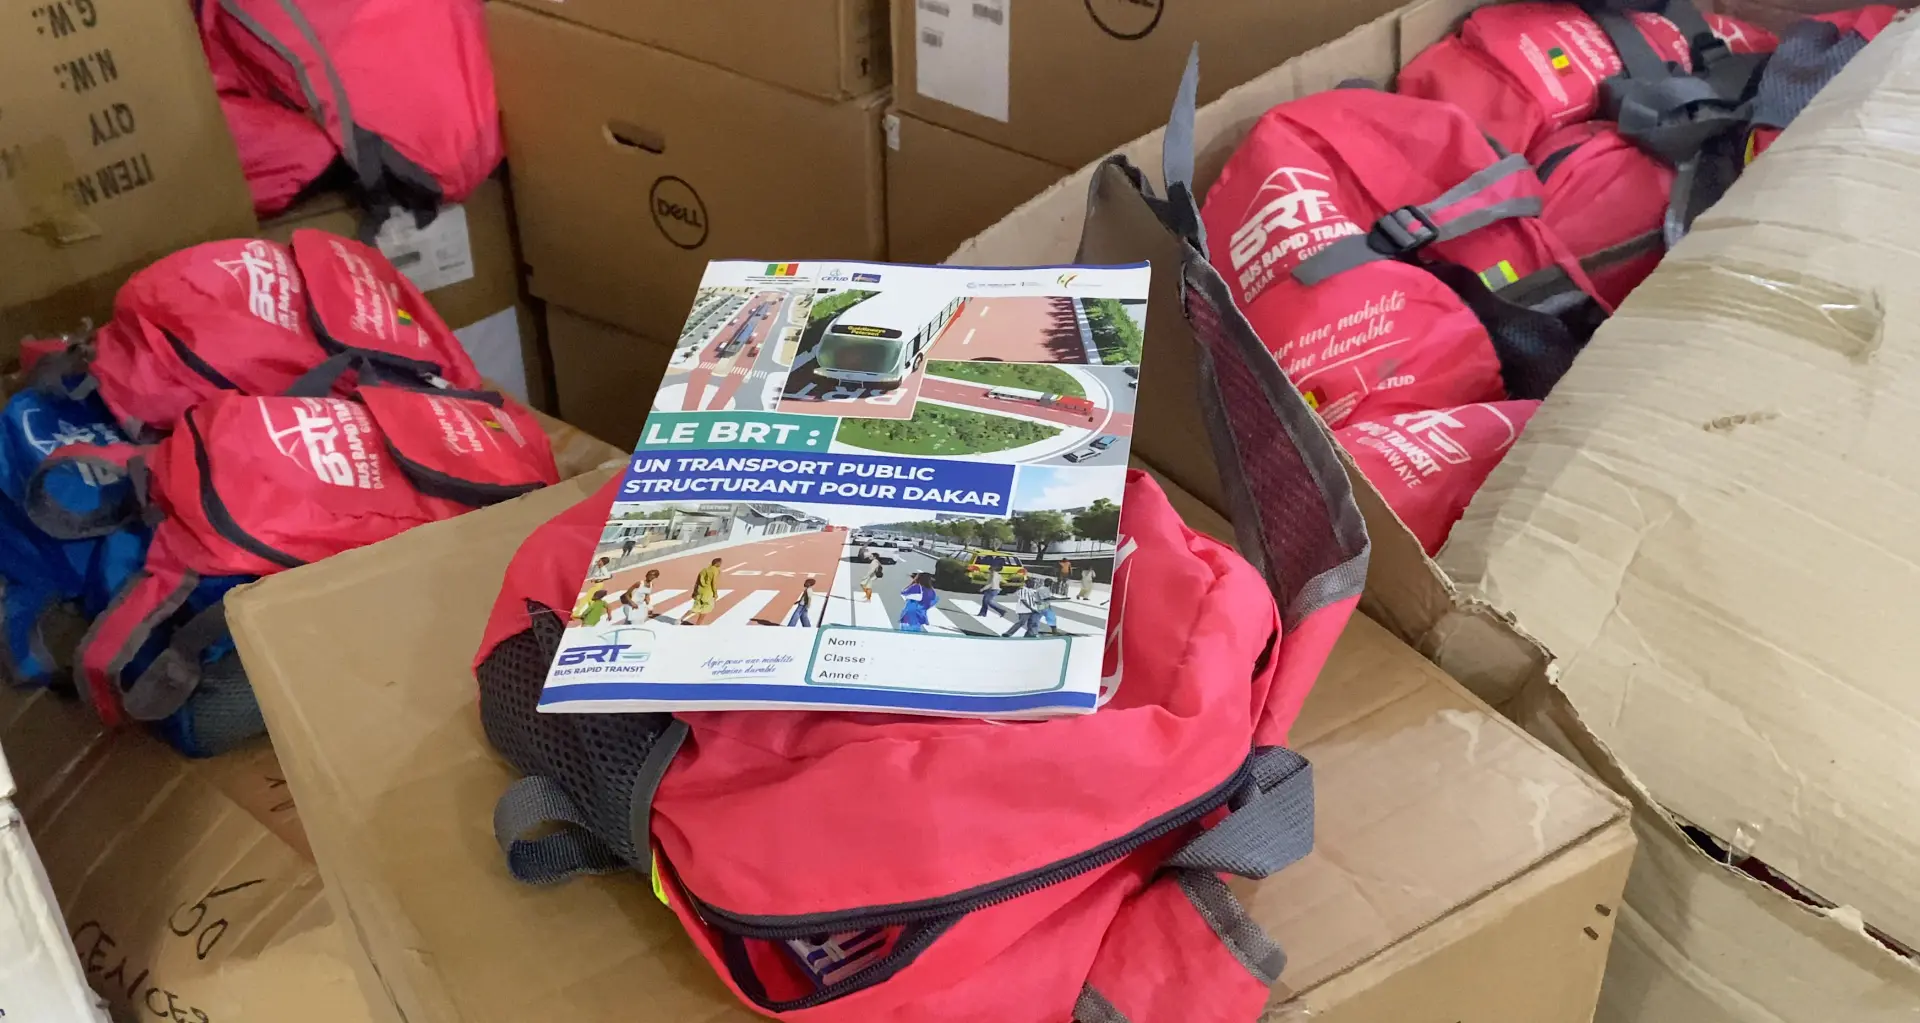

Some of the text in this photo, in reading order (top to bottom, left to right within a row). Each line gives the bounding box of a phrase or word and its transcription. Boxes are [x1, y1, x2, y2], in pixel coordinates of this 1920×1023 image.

[89, 103, 135, 146] QTY
[96, 152, 155, 199] ITEM
[657, 198, 703, 228] DELL
[1239, 221, 1367, 290] BUS RAPID TRAN
[1300, 324, 1332, 348] une
[1321, 315, 1395, 361] durable
[645, 422, 699, 444] LE
[707, 421, 800, 445] BRT
[1383, 430, 1443, 478] TRANSIT
[633, 458, 936, 481] UN TRANSPORT PUBLIC
[623, 478, 1001, 507] STRUCTURANT POUR DAKAR
[828, 638, 857, 647] Nom
[557, 644, 632, 666] BRT
[824, 653, 866, 664] Classe
[554, 665, 645, 677] BUS RAPID TRANSIT
[819, 670, 860, 681] Année
